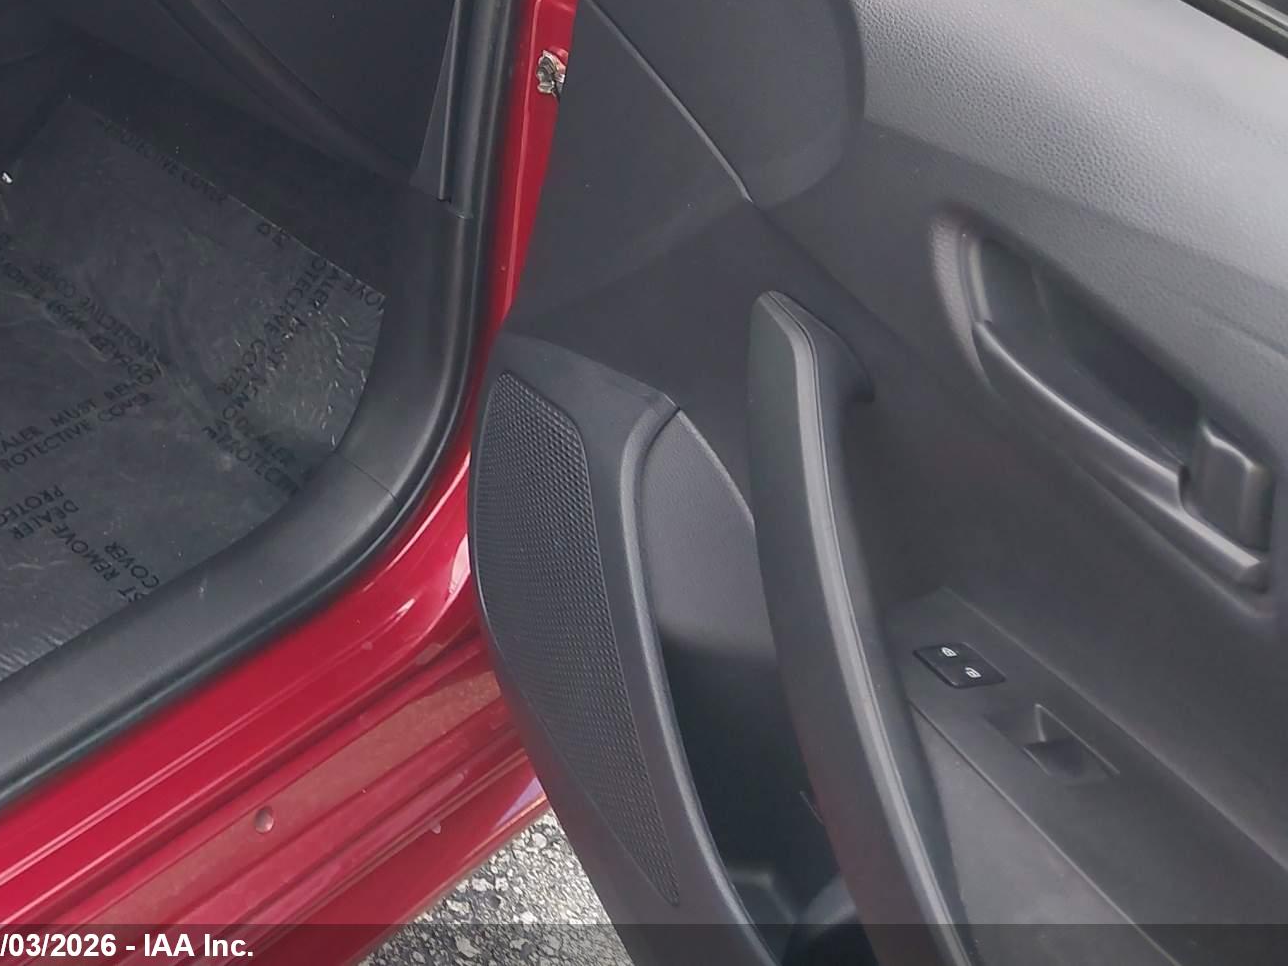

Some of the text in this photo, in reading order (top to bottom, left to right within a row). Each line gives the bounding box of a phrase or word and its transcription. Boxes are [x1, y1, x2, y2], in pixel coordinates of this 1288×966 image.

[50, 398, 98, 427] MUST
[12, 498, 80, 541] DEALER
[51, 525, 120, 582] REMOVE
[105, 541, 160, 591] COVER
